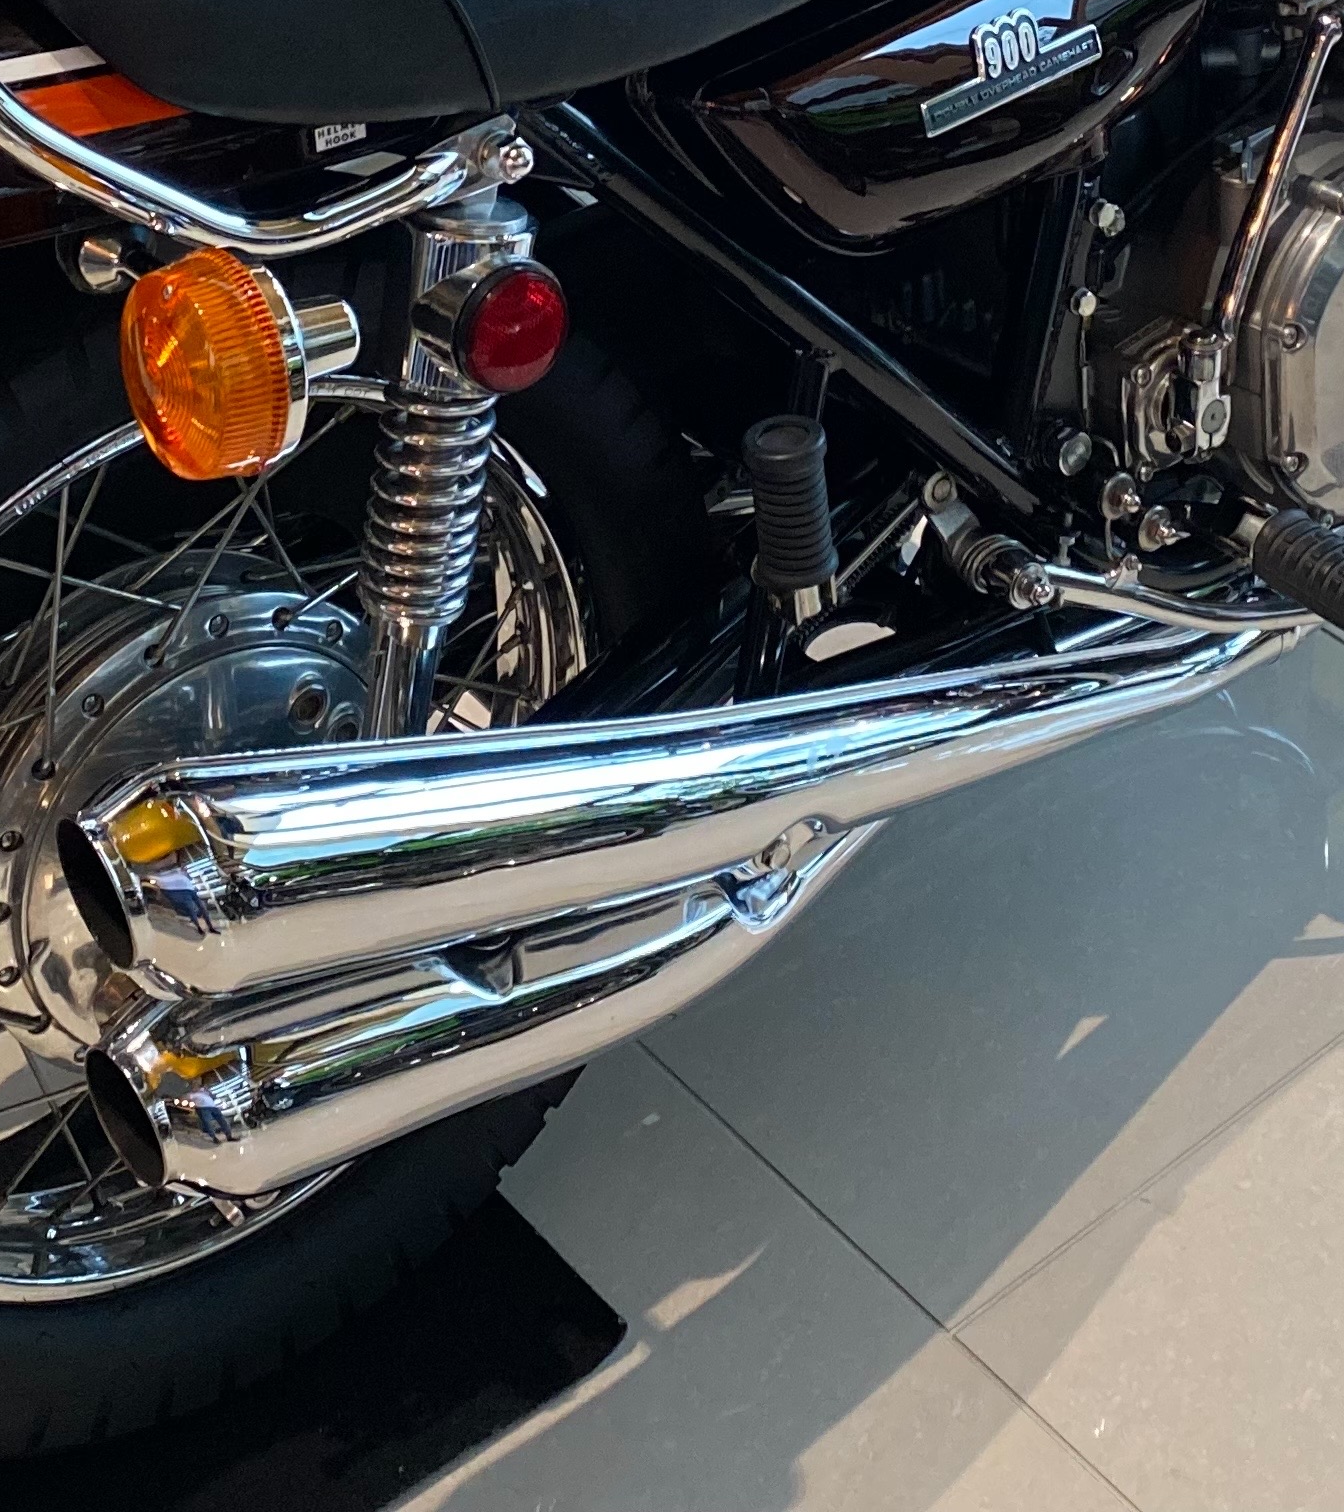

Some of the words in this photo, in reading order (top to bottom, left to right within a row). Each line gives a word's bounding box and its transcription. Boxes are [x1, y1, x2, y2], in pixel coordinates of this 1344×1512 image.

[979, 65, 1038, 100] OVERHEAD
[1038, 38, 1094, 72] CAMSHAFT
[983, 21, 1037, 79] 900
[317, 121, 356, 139] HELM
[325, 131, 356, 148] HOOK
